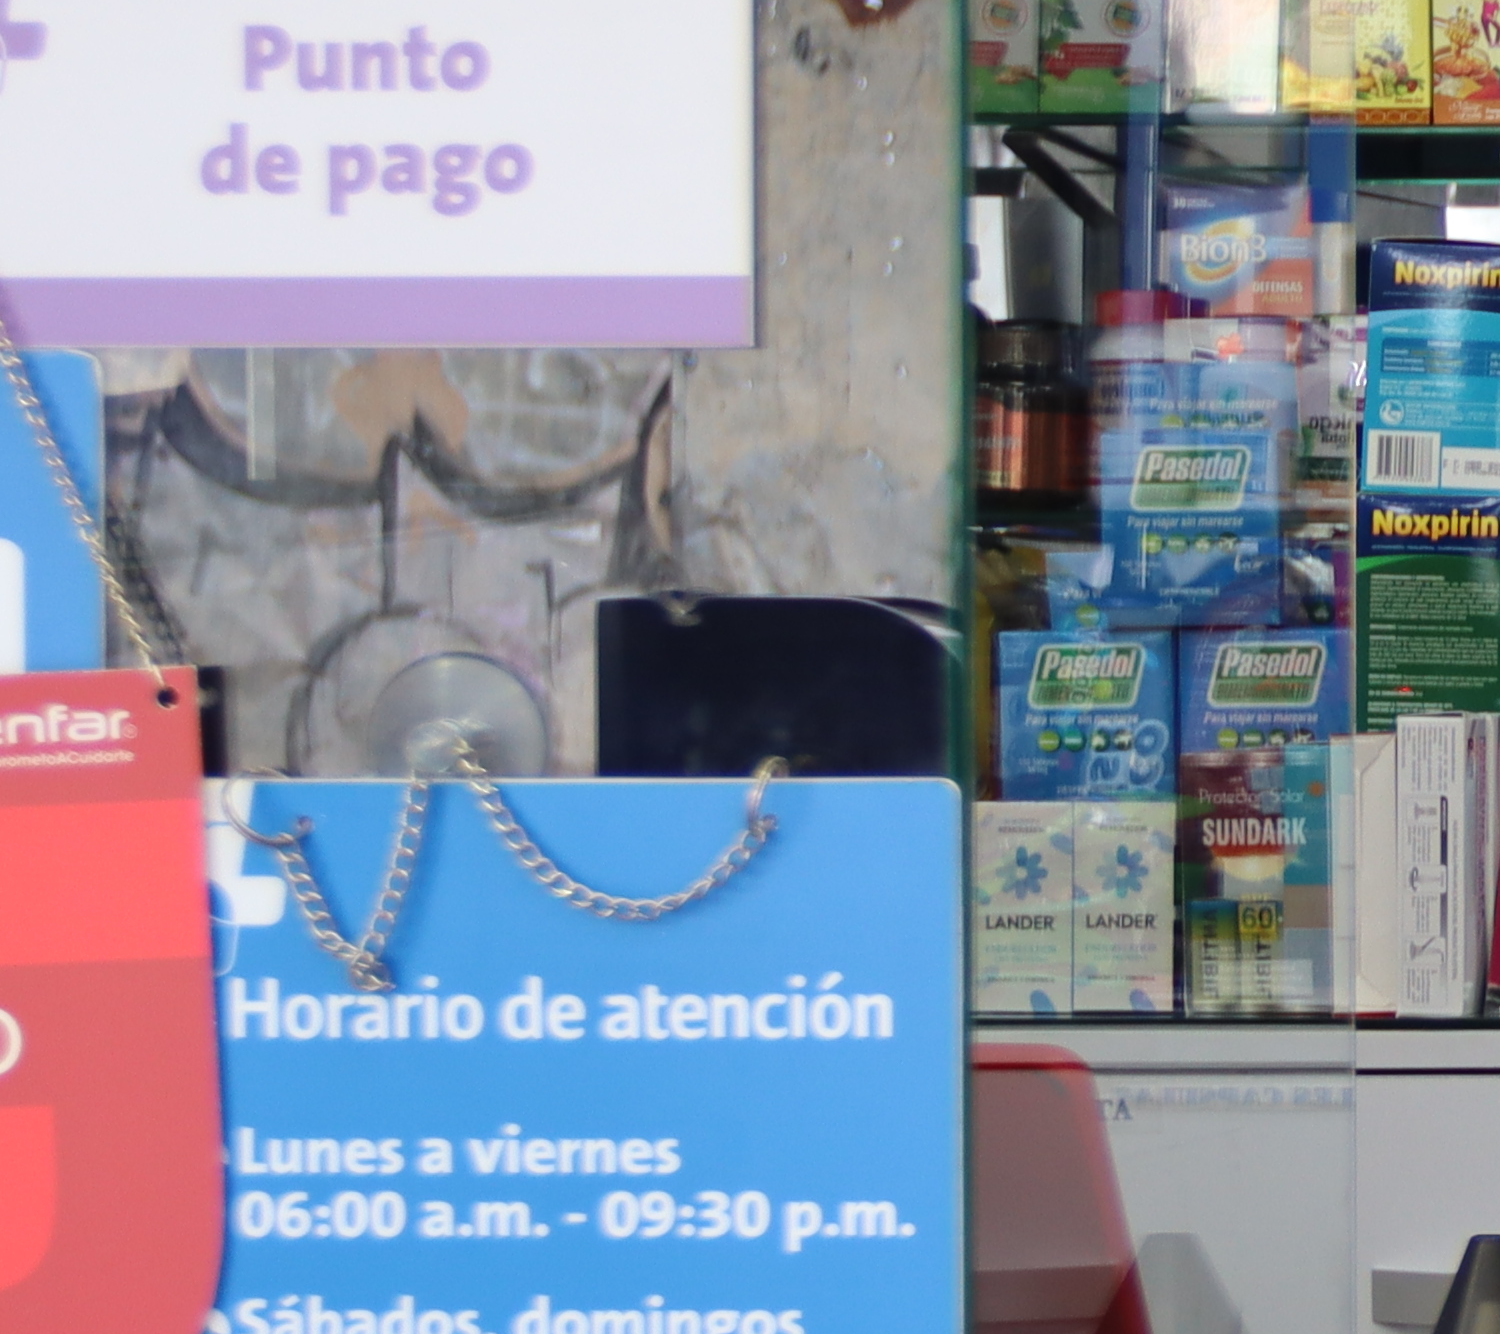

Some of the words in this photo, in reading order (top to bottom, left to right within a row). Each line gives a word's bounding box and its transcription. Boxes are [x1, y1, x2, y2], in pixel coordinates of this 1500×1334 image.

[241, 22, 492, 92] Punto
[199, 122, 301, 196] de
[328, 137, 536, 216] pago
[1180, 232, 1268, 265] Bion3
[1143, 452, 1244, 483] Pasedol
[1371, 508, 1500, 540] Noxpirin
[1201, 815, 1308, 847] SUNDARK
[985, 913, 1056, 931] LANDER
[228, 976, 484, 1041] Horario
[499, 976, 585, 1041] de
[601, 973, 894, 1041] atención
[237, 1125, 406, 1175] Lunes
[419, 1135, 454, 1175] a
[469, 1125, 682, 1177] viernes
[236, 1192, 407, 1240] 06:00
[419, 1198, 552, 1240] a.m.
[598, 1192, 772, 1240] 09:30
[782, 1200, 916, 1253] p.m.
